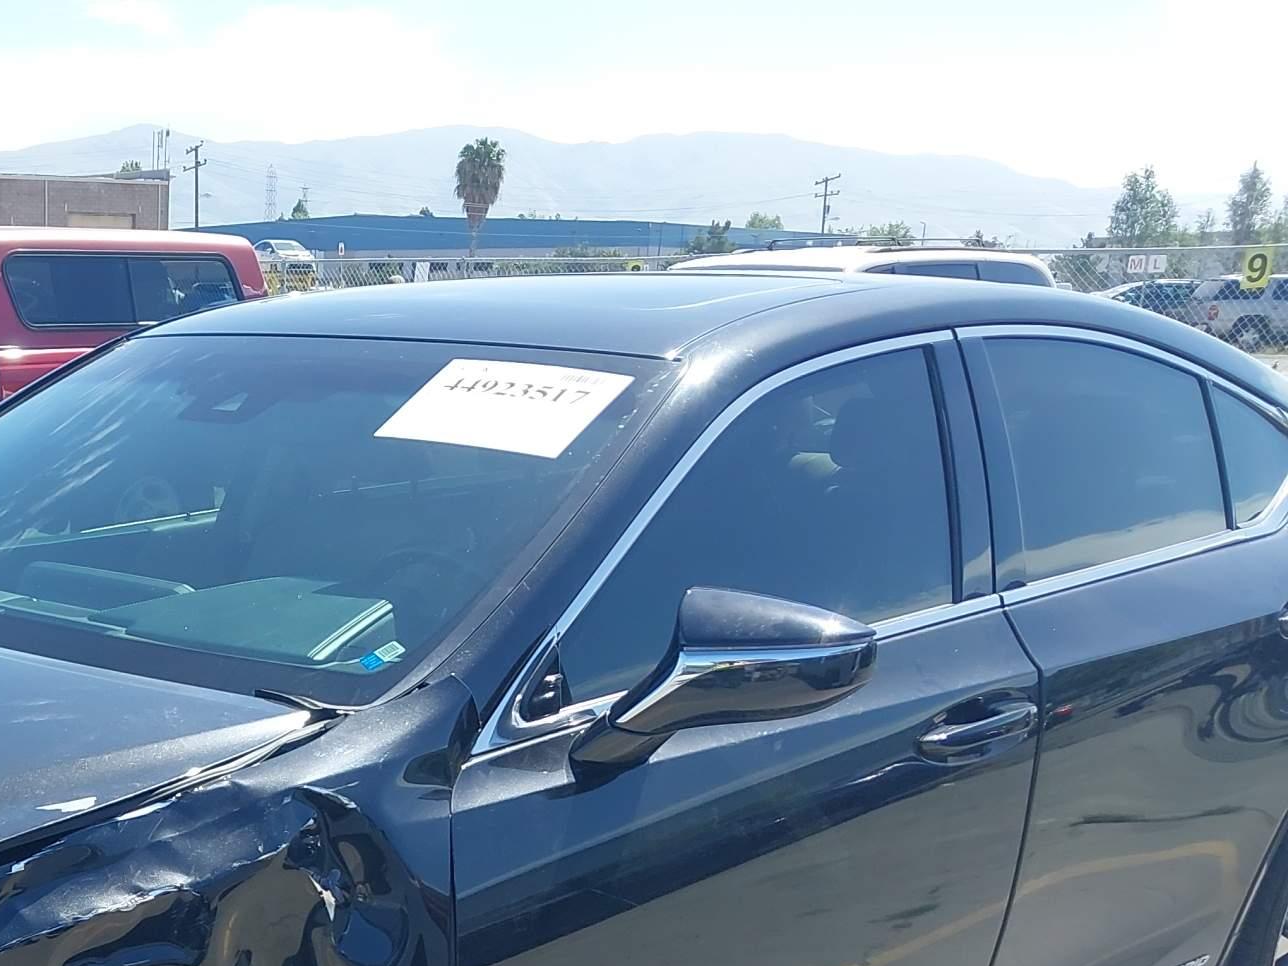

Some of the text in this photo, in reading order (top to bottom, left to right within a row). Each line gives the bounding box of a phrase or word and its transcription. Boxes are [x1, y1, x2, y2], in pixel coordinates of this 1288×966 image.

[1129, 258, 1161, 270] M L
[1245, 253, 1268, 283] 9
[443, 377, 591, 405] 44923517
